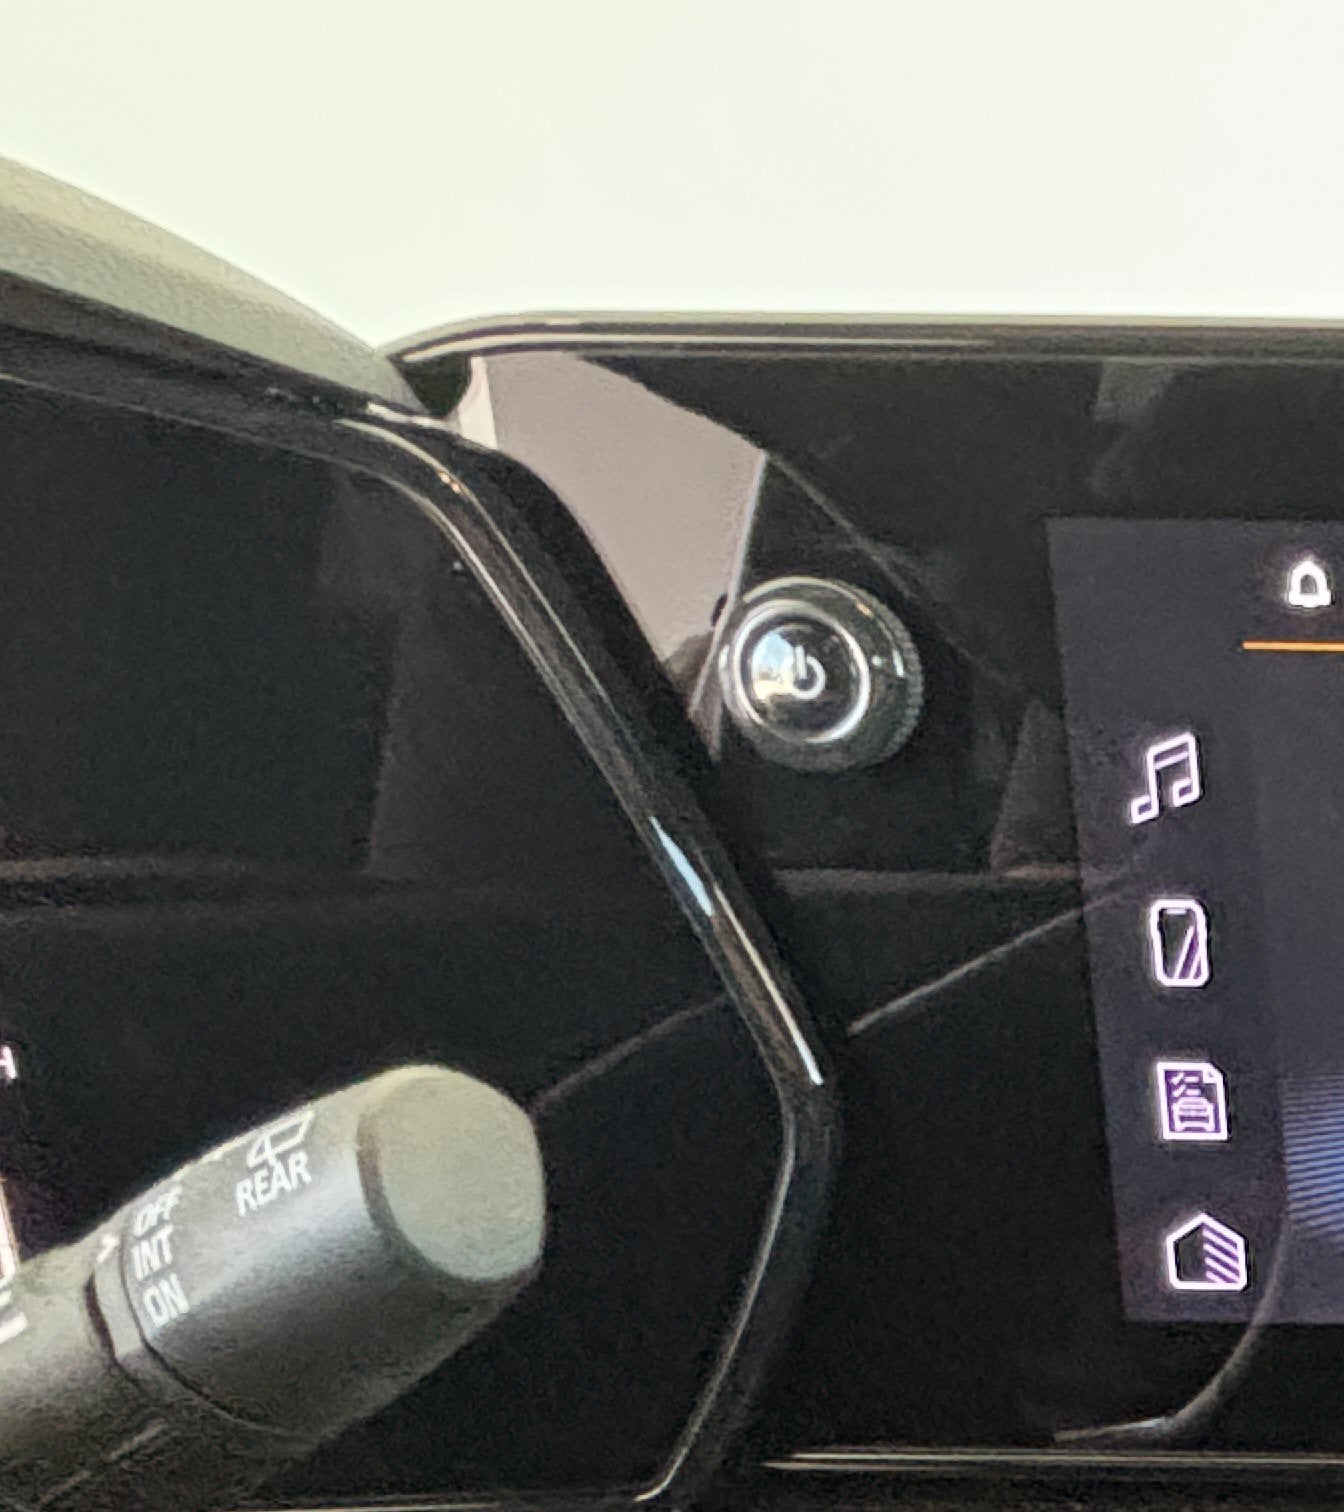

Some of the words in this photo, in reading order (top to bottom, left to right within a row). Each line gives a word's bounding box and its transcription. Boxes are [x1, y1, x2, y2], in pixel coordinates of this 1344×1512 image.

[132, 1185, 184, 1237] OFF
[234, 1151, 313, 1218] REAR
[131, 1224, 173, 1282] INT
[142, 1272, 190, 1328] ON
